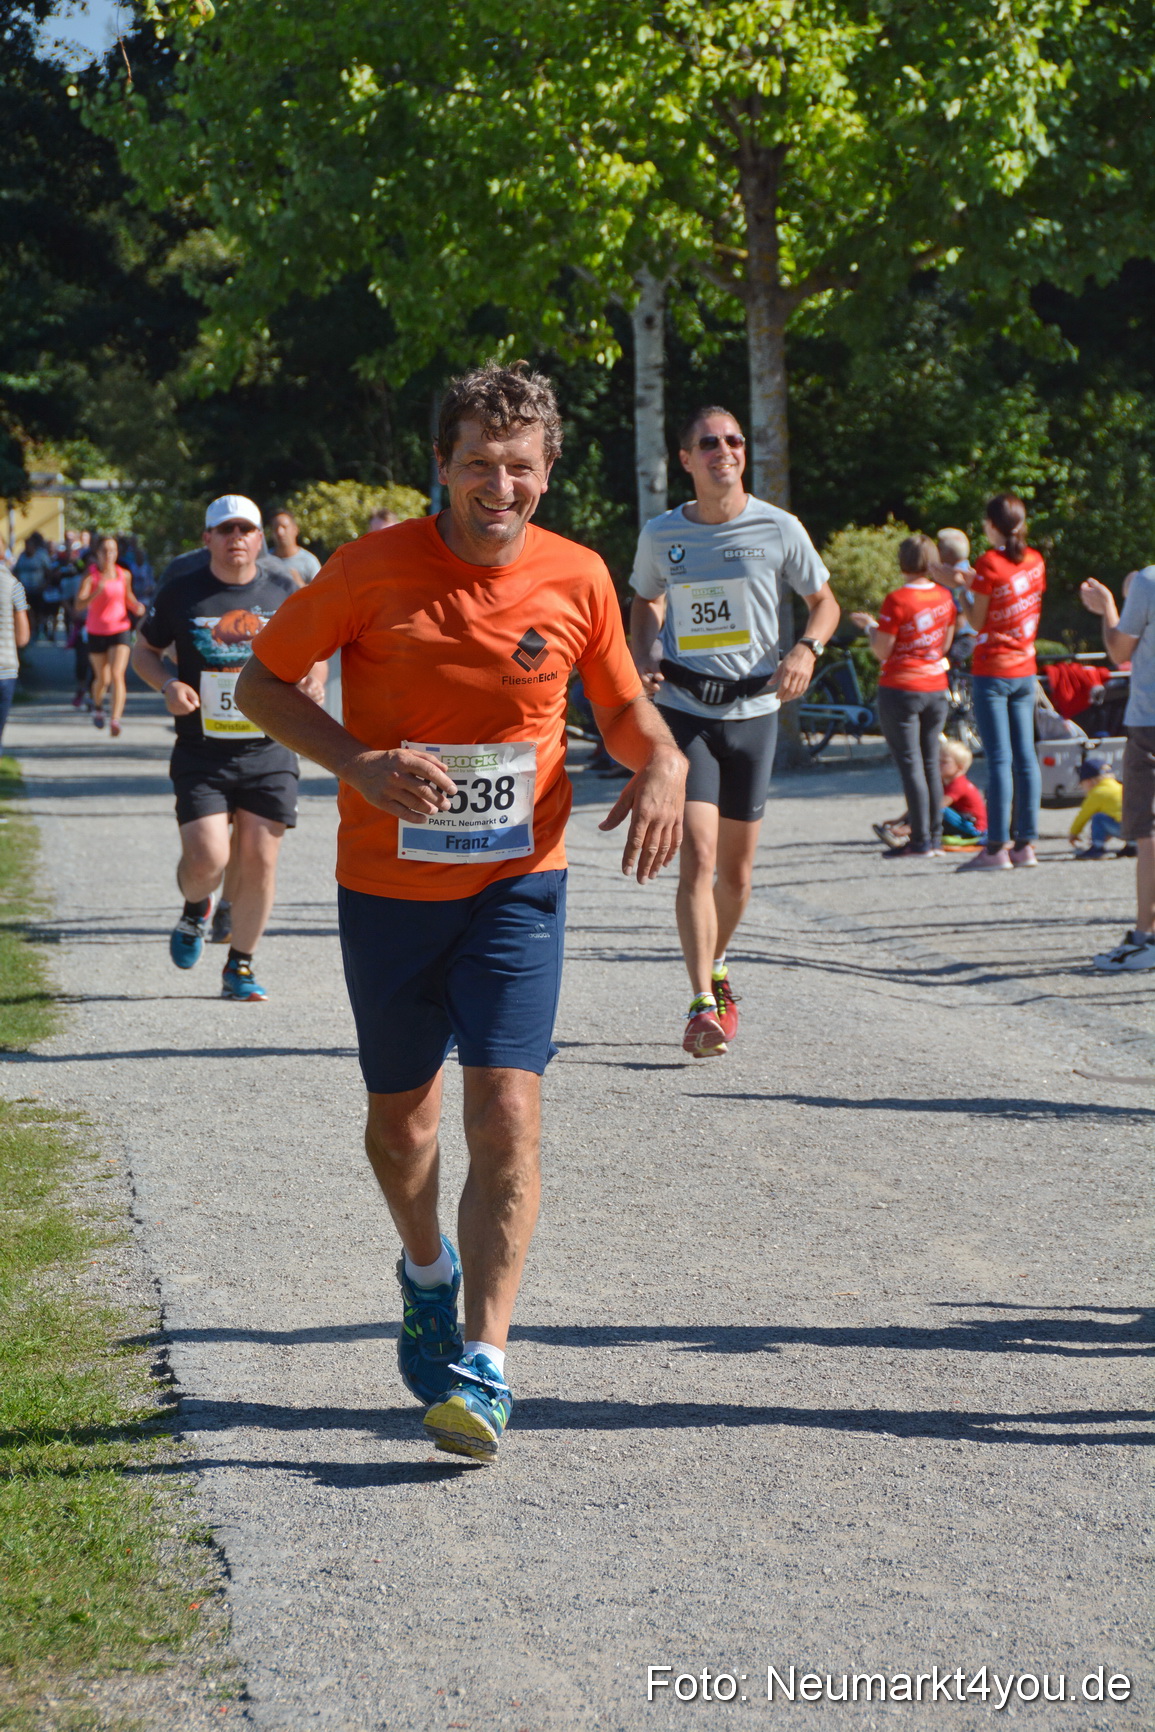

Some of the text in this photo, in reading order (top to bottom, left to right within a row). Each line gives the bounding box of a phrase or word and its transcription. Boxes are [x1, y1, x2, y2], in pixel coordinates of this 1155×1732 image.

[724, 549, 765, 559] BOCK
[691, 600, 731, 624] 354
[502, 670, 558, 686] FliesenEichl
[214, 721, 251, 731] Christian
[441, 754, 498, 768] BOCK
[429, 818, 497, 827] PARTL Neumarkt
[446, 835, 490, 850] Franz
